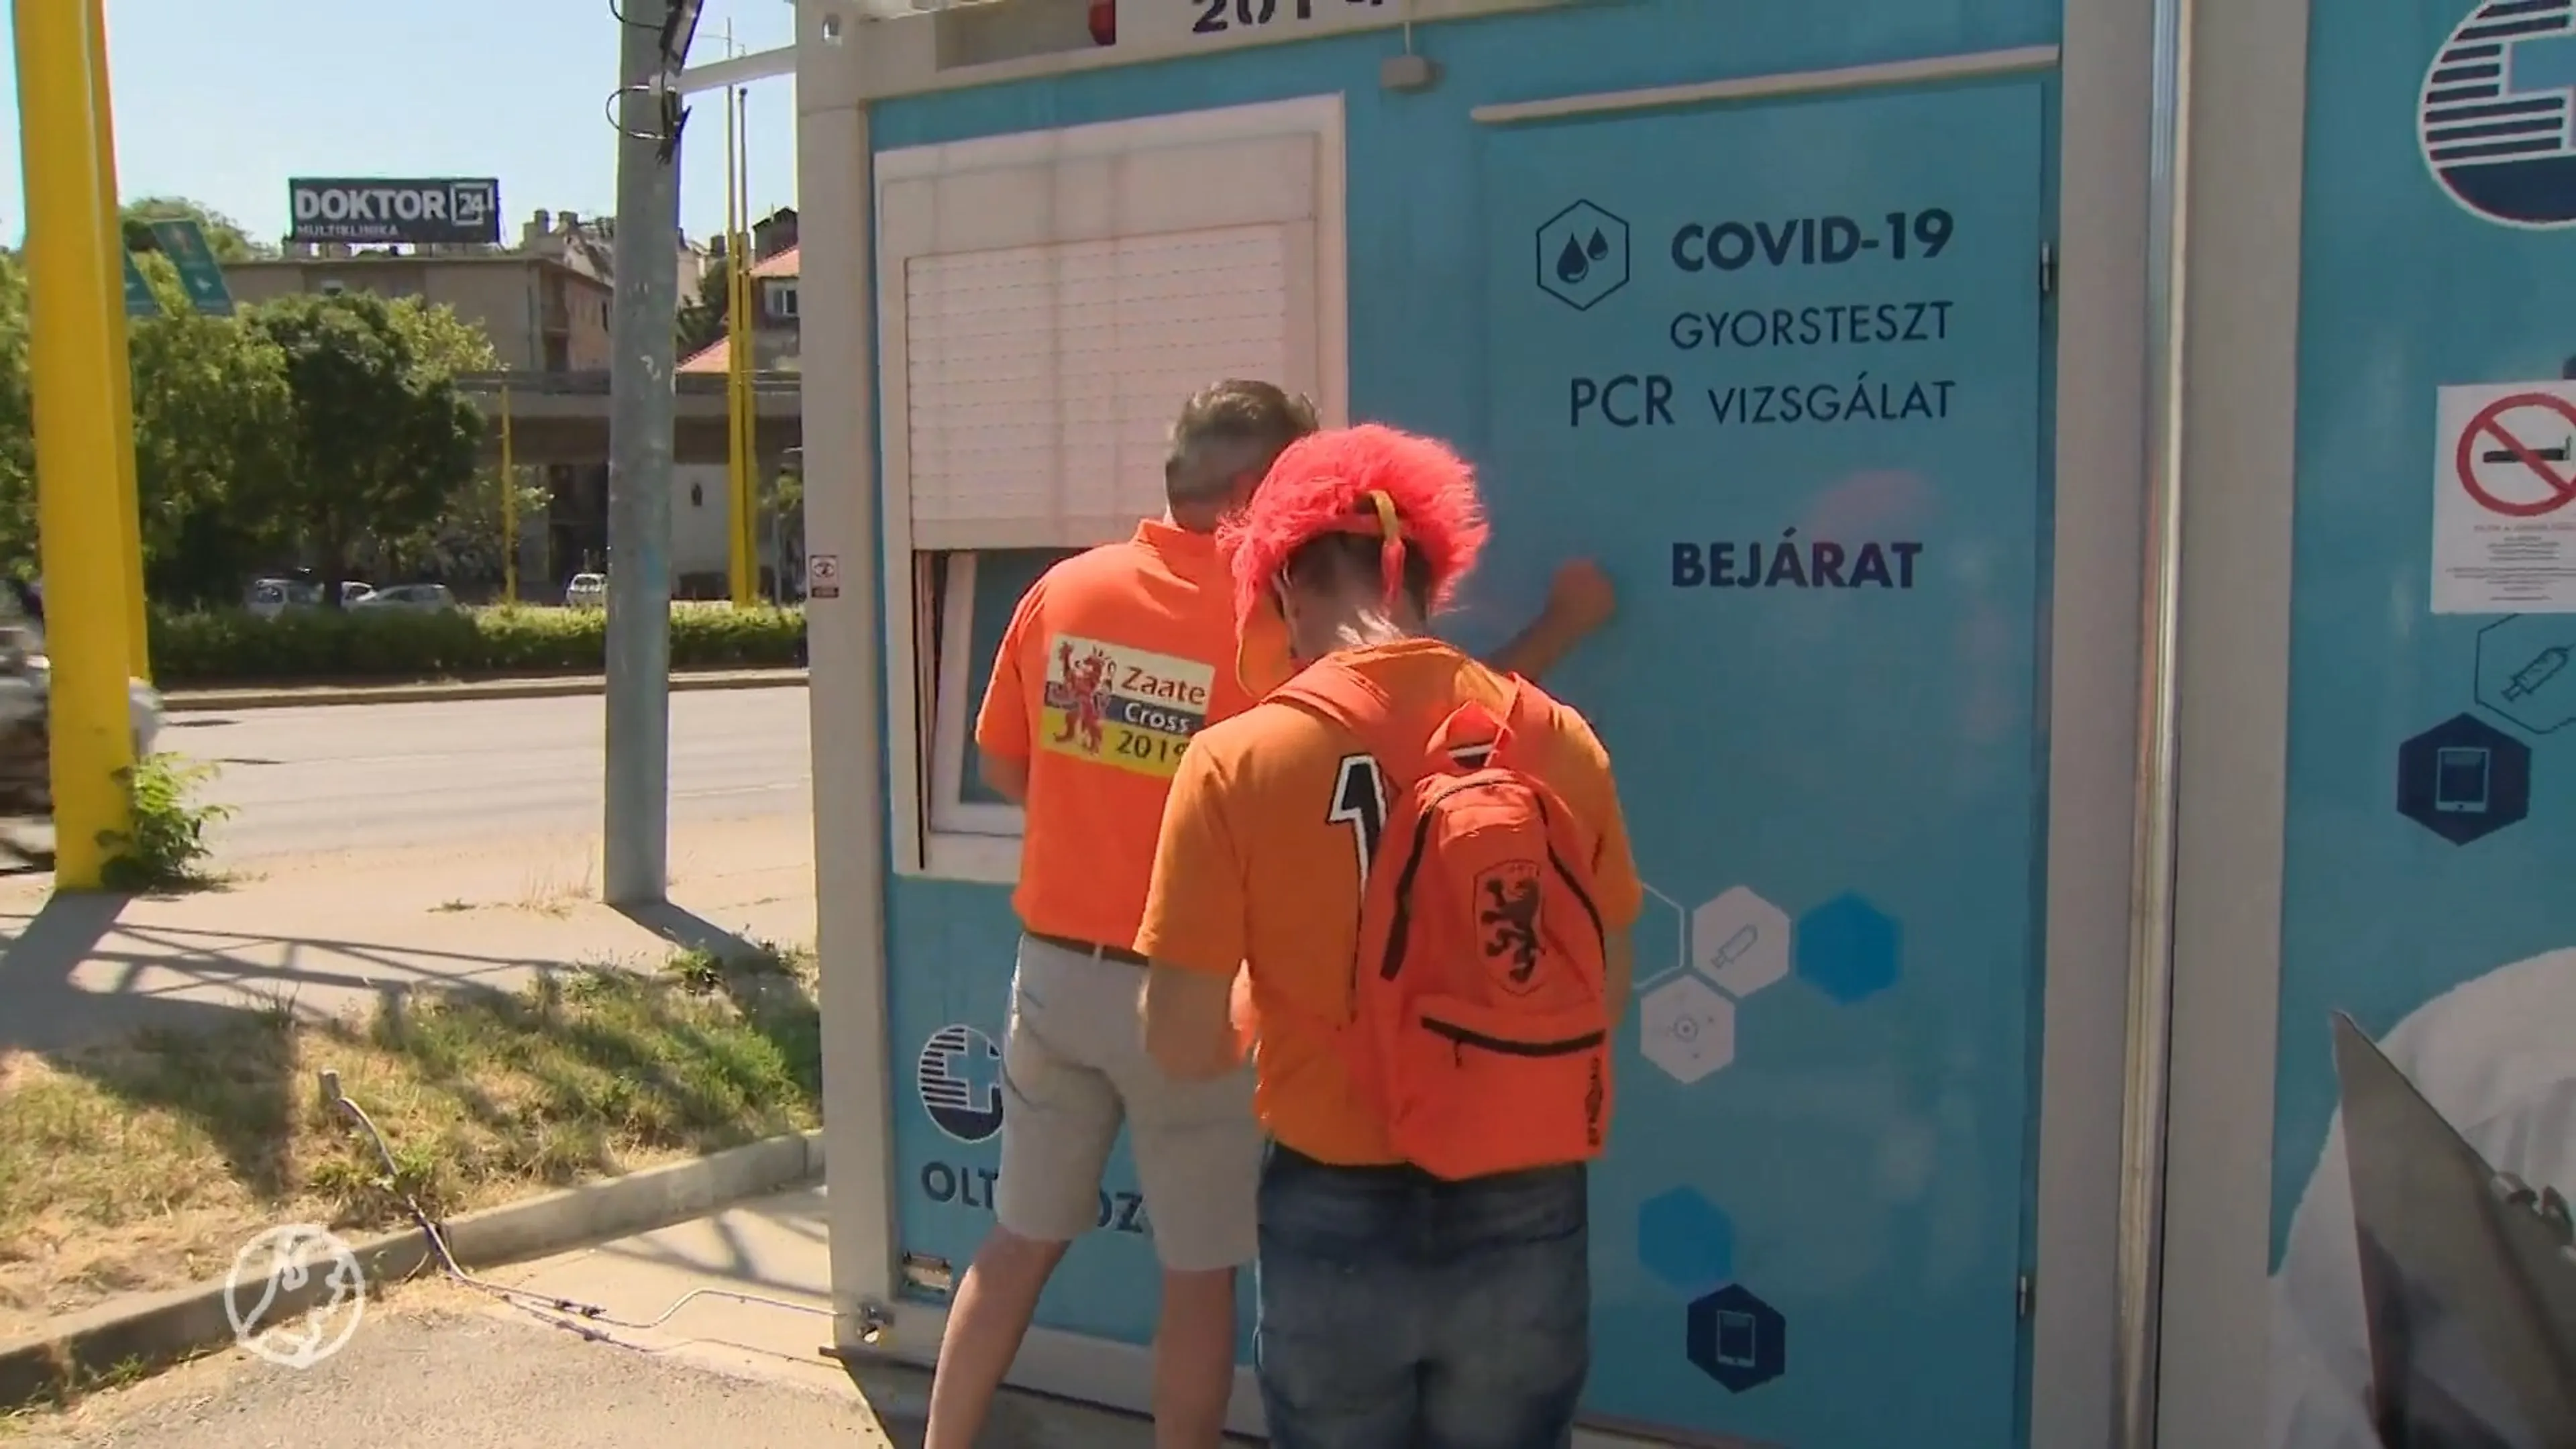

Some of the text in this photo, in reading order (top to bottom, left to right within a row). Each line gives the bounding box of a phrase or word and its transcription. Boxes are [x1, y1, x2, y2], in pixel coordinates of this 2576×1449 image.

[295, 189, 447, 221] DOKTOR
[1671, 208, 1954, 272] COVID-19
[1670, 301, 1954, 350] GYORSTESZT
[1570, 371, 1956, 427] PCR VIZSGÁLAT
[1672, 526, 1923, 589] BEJÁRAT
[1120, 665, 1205, 705] Zaate
[1123, 702, 1191, 733] Cross
